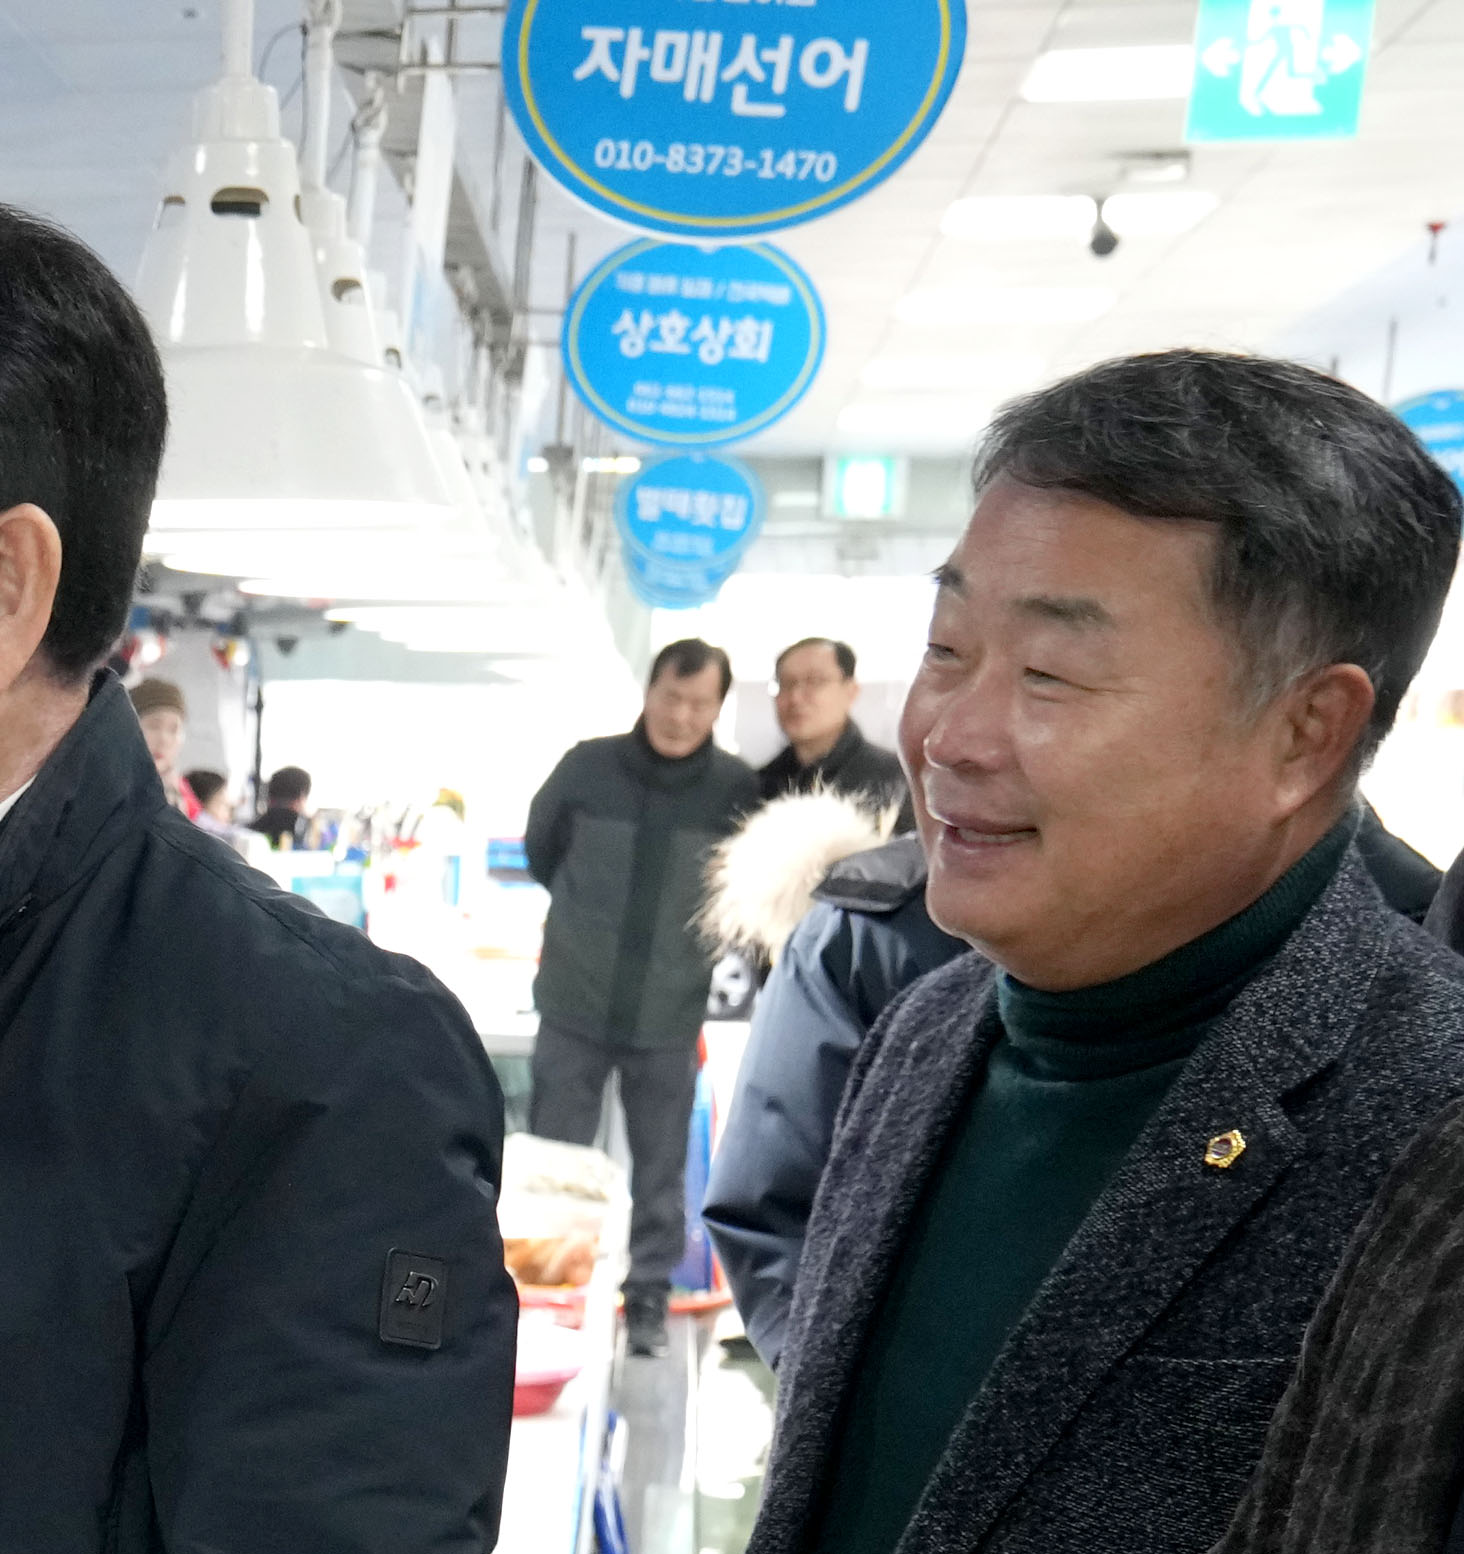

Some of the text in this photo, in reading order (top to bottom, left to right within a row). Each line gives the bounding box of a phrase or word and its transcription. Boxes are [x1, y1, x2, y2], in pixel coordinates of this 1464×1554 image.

[572, 25, 869, 118] 자매선어
[594, 138, 837, 183] 010-8373-1470
[611, 308, 773, 365] 상호상회
